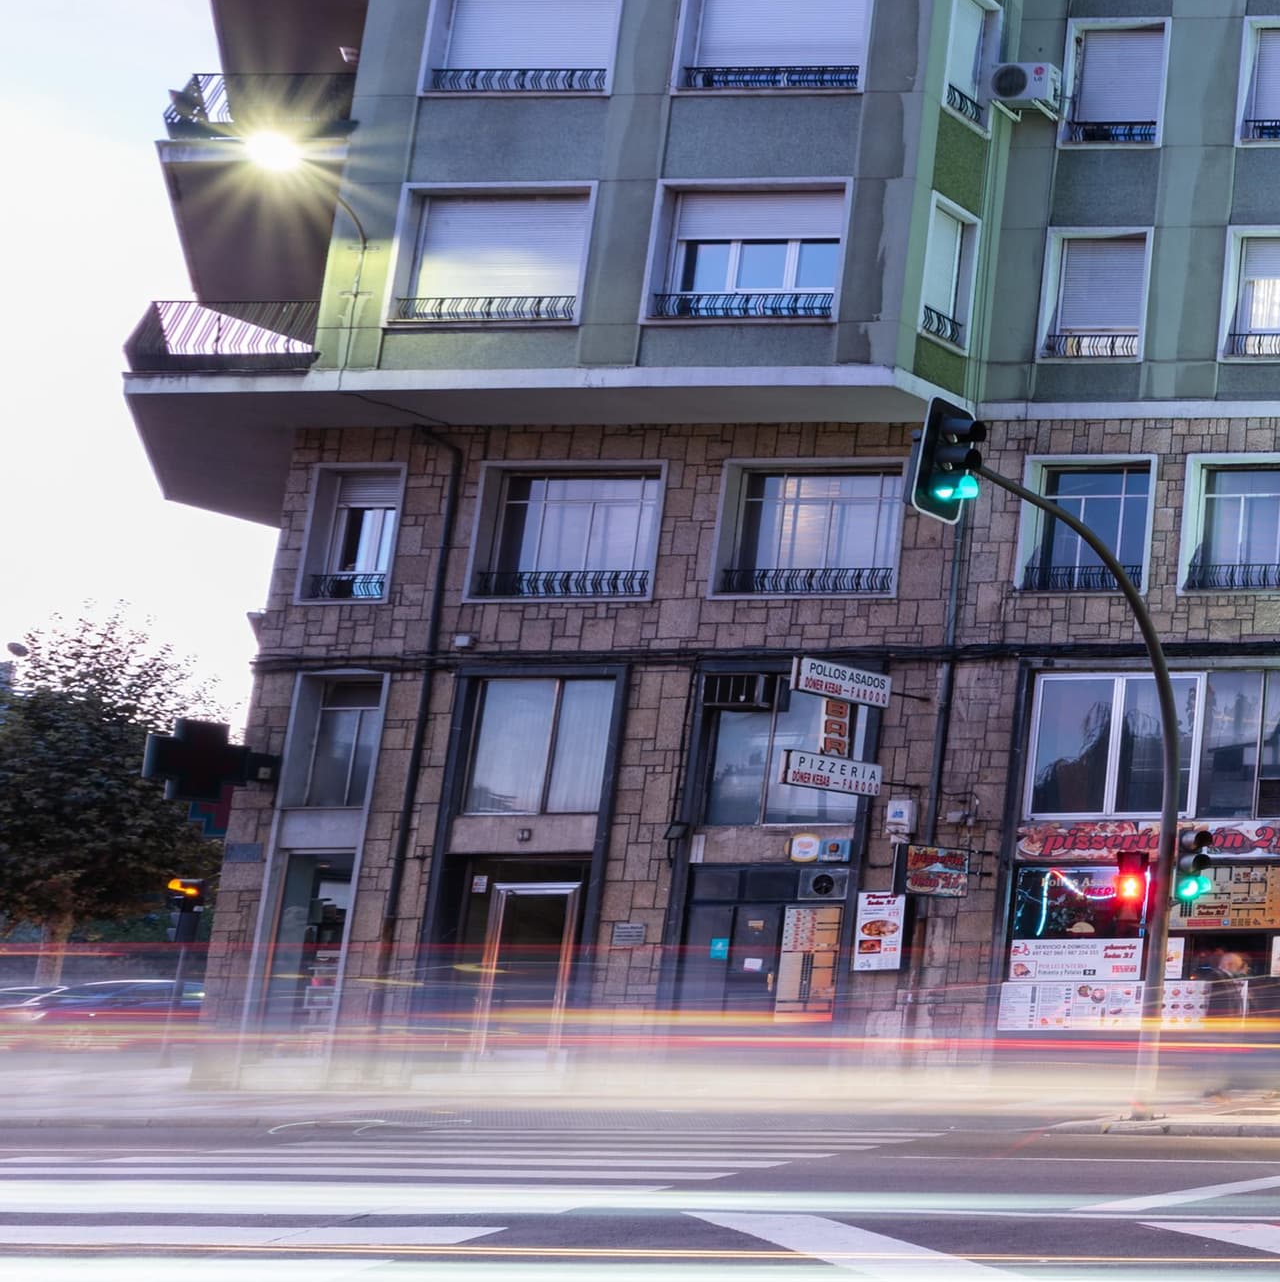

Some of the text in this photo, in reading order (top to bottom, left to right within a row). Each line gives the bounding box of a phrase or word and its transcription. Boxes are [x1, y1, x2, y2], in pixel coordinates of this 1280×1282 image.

[809, 662, 886, 690] POLLOS ASADOS
[824, 699, 849, 756] BAR
